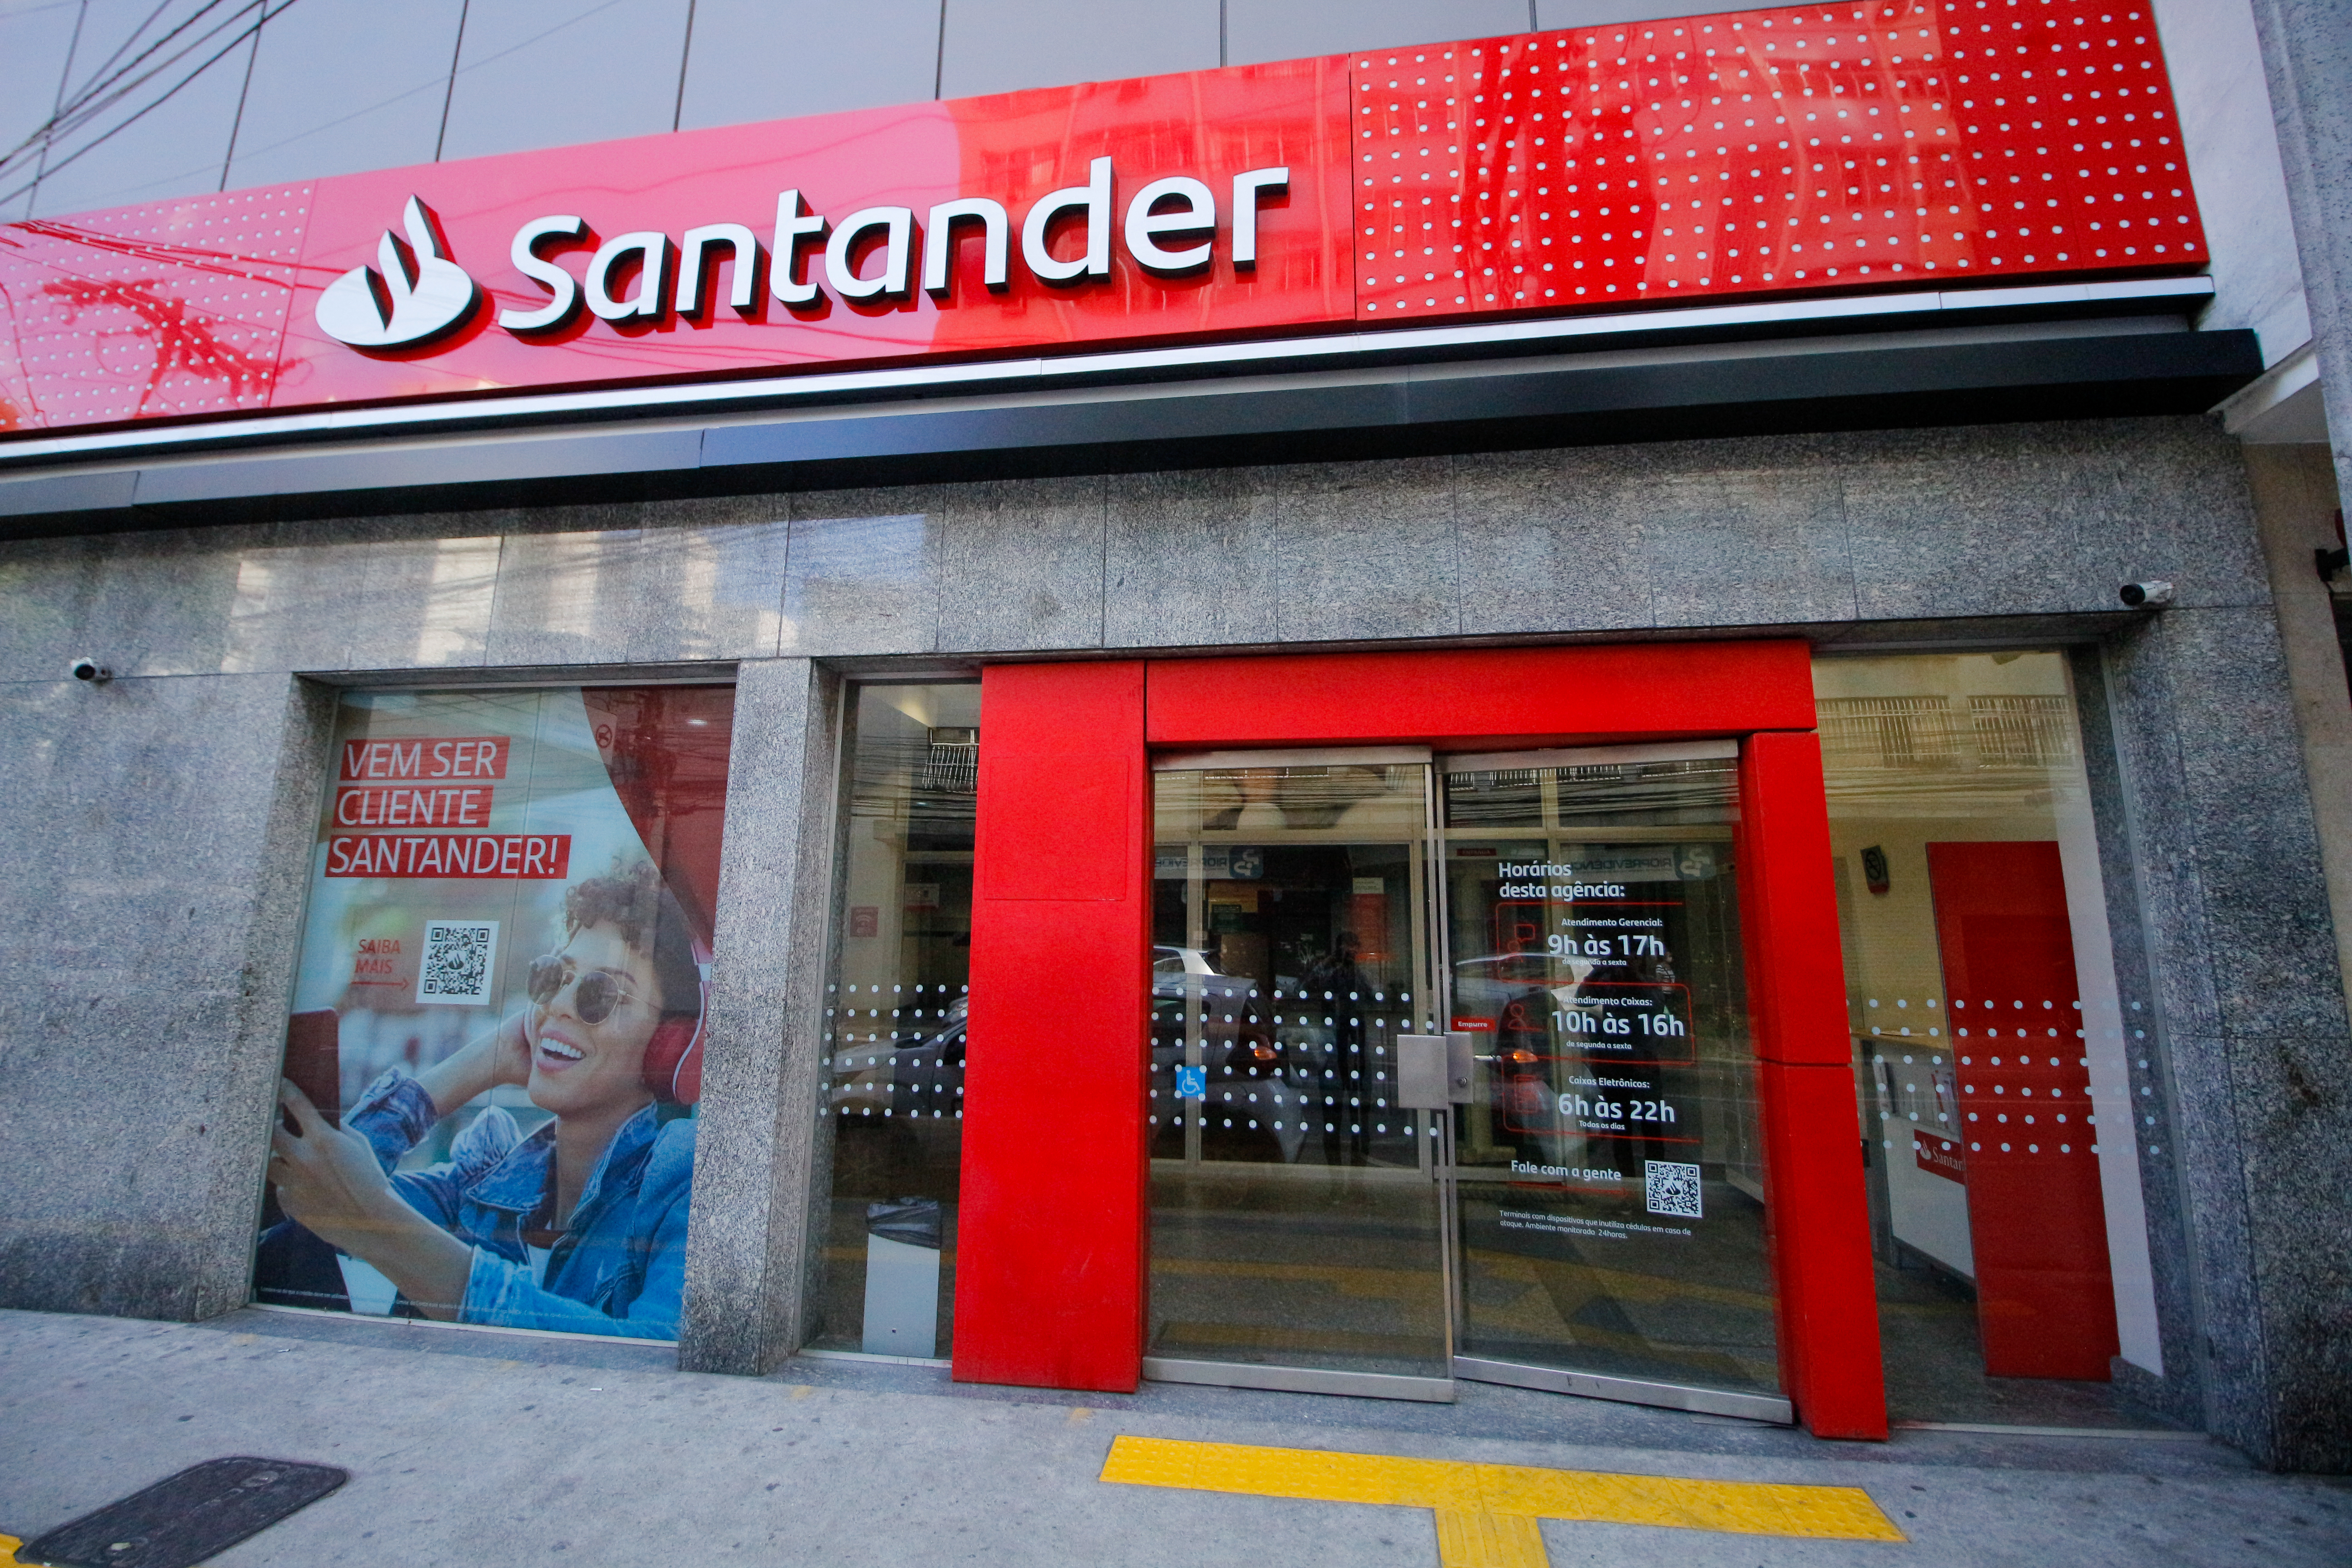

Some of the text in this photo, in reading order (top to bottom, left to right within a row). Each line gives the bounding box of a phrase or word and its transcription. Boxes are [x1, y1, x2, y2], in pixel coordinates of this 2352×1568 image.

[497, 155, 1289, 333] Santander
[348, 741, 497, 778] VEM SER
[338, 789, 481, 825] CLIENTE
[329, 837, 558, 874] SANTANDER!
[1499, 860, 1572, 877] Horários
[1499, 880, 1625, 902] desta agência:
[1561, 918, 1663, 926] Atendimento Gerencial:
[358, 939, 401, 953] SAIBA
[1548, 933, 1664, 956] 9h às 17h
[355, 959, 392, 974] MAIS
[1563, 996, 1653, 1006] Atendimento Caixas:
[1552, 1010, 1685, 1036] 10h às 16h
[1576, 1041, 1605, 1049] segunda
[1568, 1076, 1650, 1088] Caixas Eletrônicos:
[1558, 1093, 1675, 1122] 6h às 22h
[1578, 1120, 1599, 1128] Todos
[1511, 1160, 1622, 1181] Fale com a gente
[1499, 1210, 1531, 1219] Terminais
[1547, 1214, 1584, 1225] dispositivos
[1599, 1219, 1624, 1228] inutiliza
[1626, 1222, 1651, 1231] cédulas
[1500, 1220, 1628, 1239] ataque. Ambiente monitorado 24horas.
